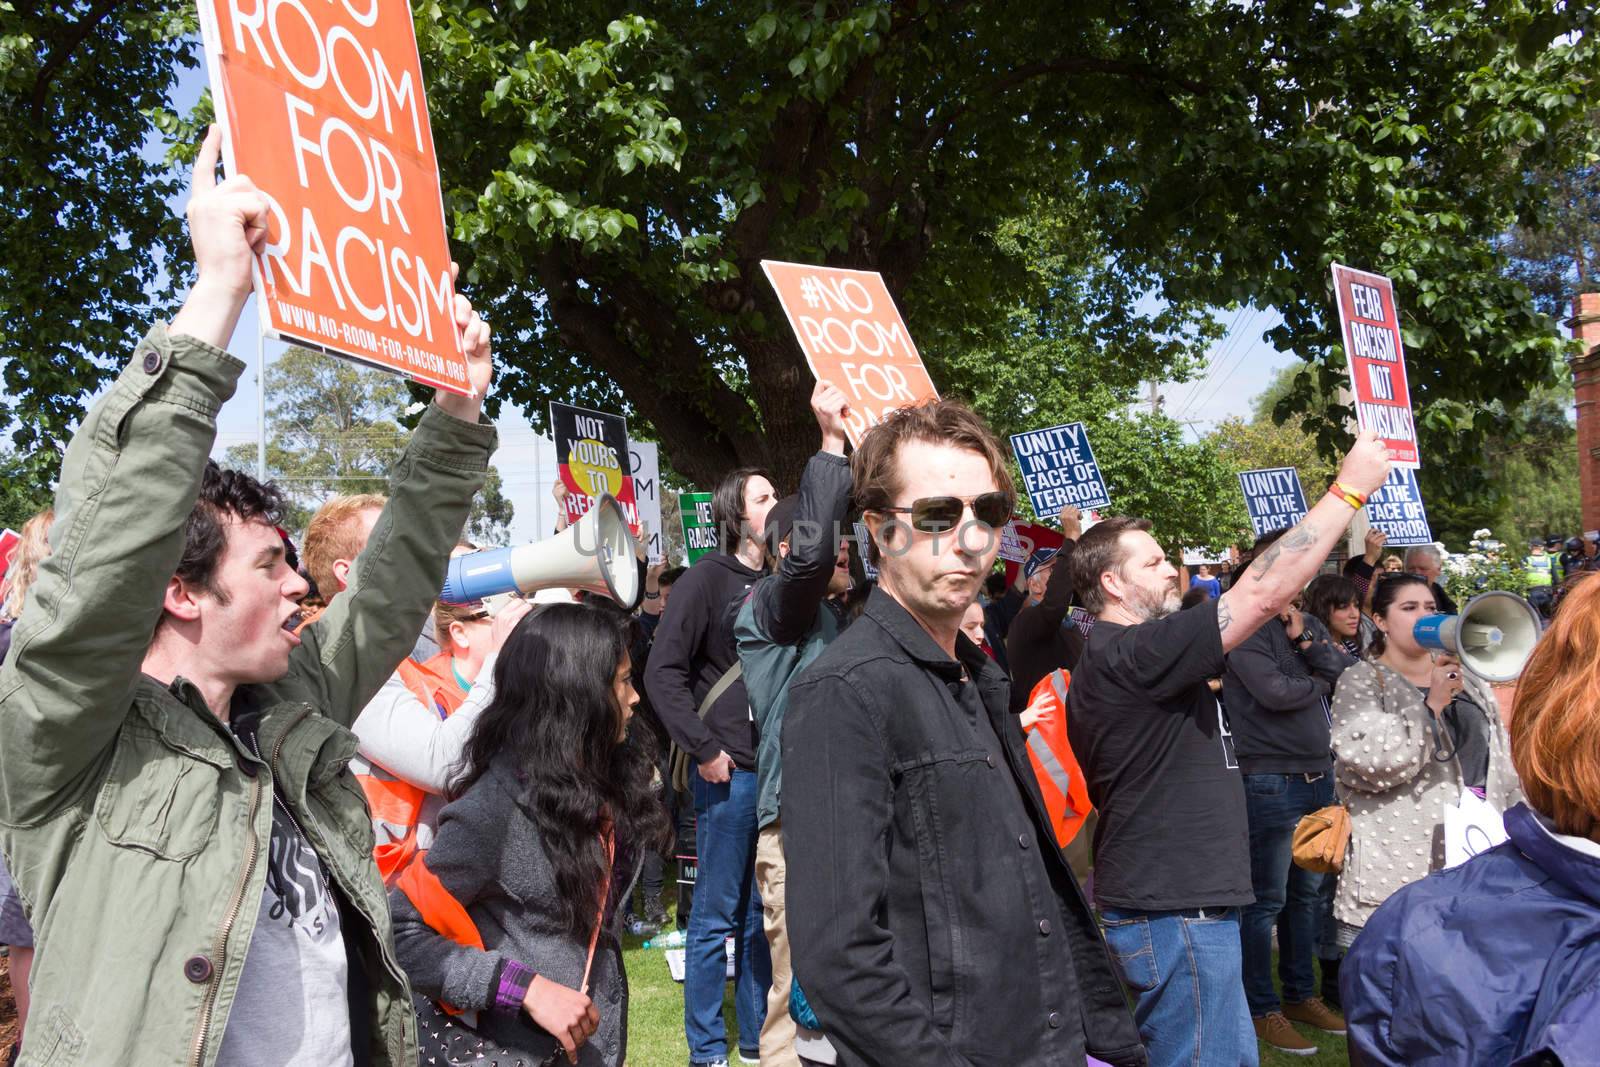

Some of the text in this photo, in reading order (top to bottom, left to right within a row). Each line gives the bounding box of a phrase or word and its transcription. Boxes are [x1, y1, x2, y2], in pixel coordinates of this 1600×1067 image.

[228, 0, 424, 153] ROOM
[284, 91, 411, 234] FOR
[256, 189, 462, 354] RACISM
[800, 275, 873, 314] #NO
[1350, 282, 1385, 322] FEAR
[277, 300, 466, 382] WWW.NO-ROOM-FOR-RACISM.ORG
[799, 315, 913, 358] ROOM
[1350, 321, 1398, 363] RACISM
[840, 362, 916, 401] FOR
[1367, 363, 1393, 400] NOT
[574, 414, 605, 441] NOT
[1361, 402, 1413, 441] MUSLIMS
[567, 438, 620, 470] YOURS
[1015, 425, 1080, 457] UNITY
[1027, 447, 1084, 473] IN THE
[586, 469, 609, 494] TO
[1025, 462, 1096, 492] FACE OF
[1241, 470, 1295, 497] UNITY
[1031, 480, 1105, 510] TERROR
[1253, 493, 1299, 515] IN THE
[1370, 485, 1413, 503] IN THE
[1253, 514, 1288, 536] FACE
[1366, 502, 1421, 521] FACE OF
